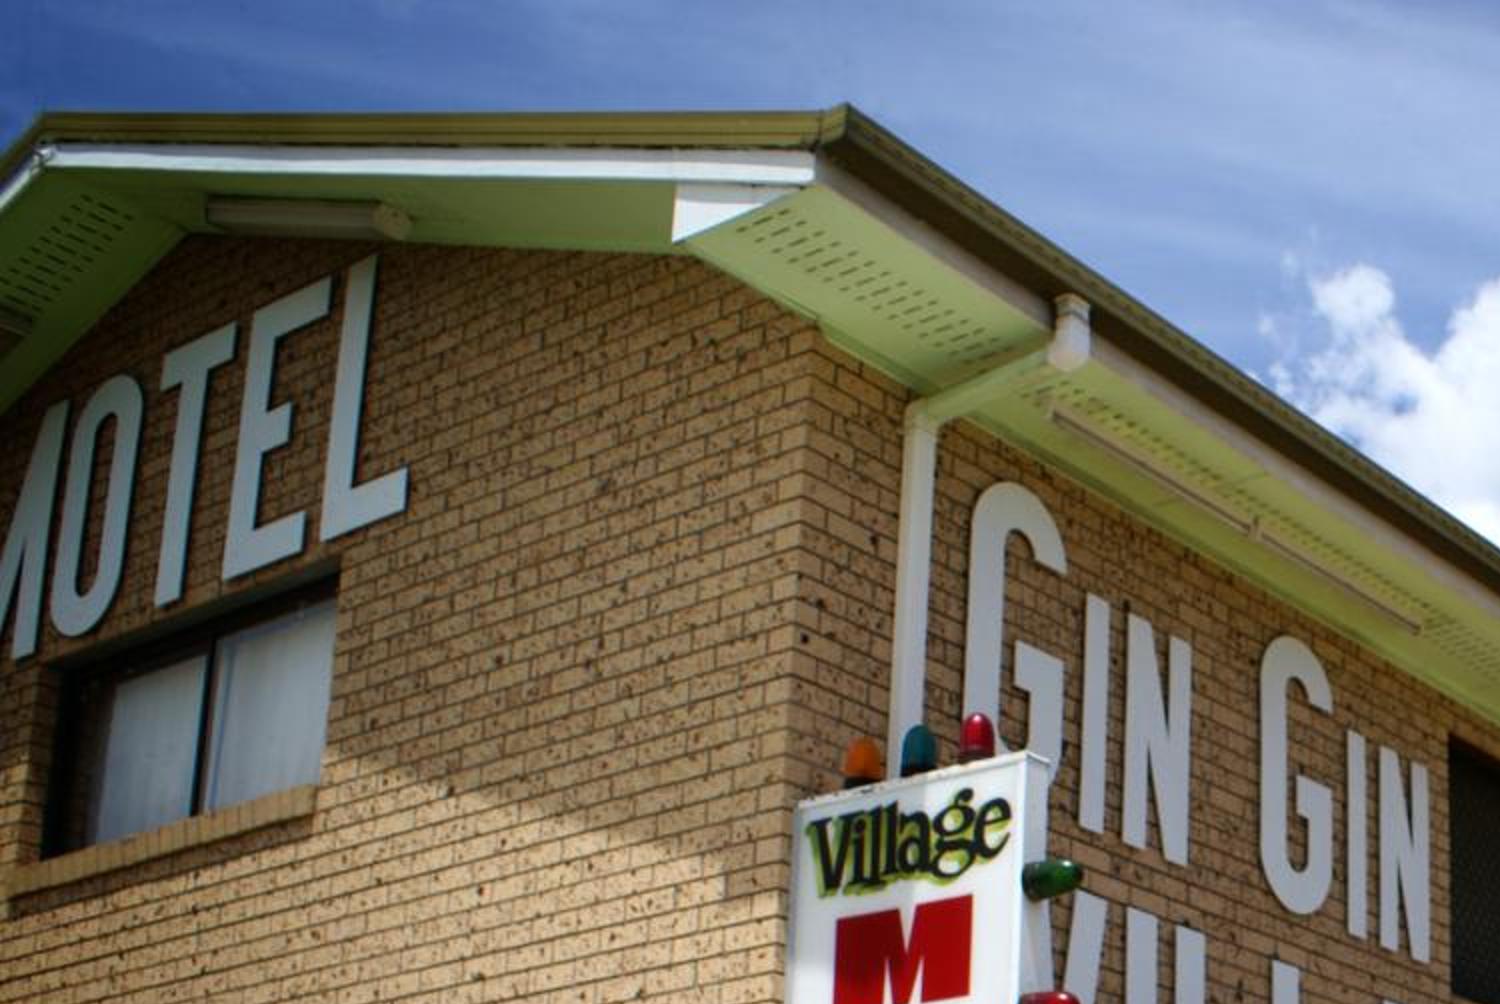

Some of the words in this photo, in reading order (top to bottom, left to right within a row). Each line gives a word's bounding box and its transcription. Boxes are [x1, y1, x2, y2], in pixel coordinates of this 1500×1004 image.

[805, 788, 1012, 897] Village
[961, 481, 1193, 867] GIN
[1260, 634, 1431, 964] GIN
